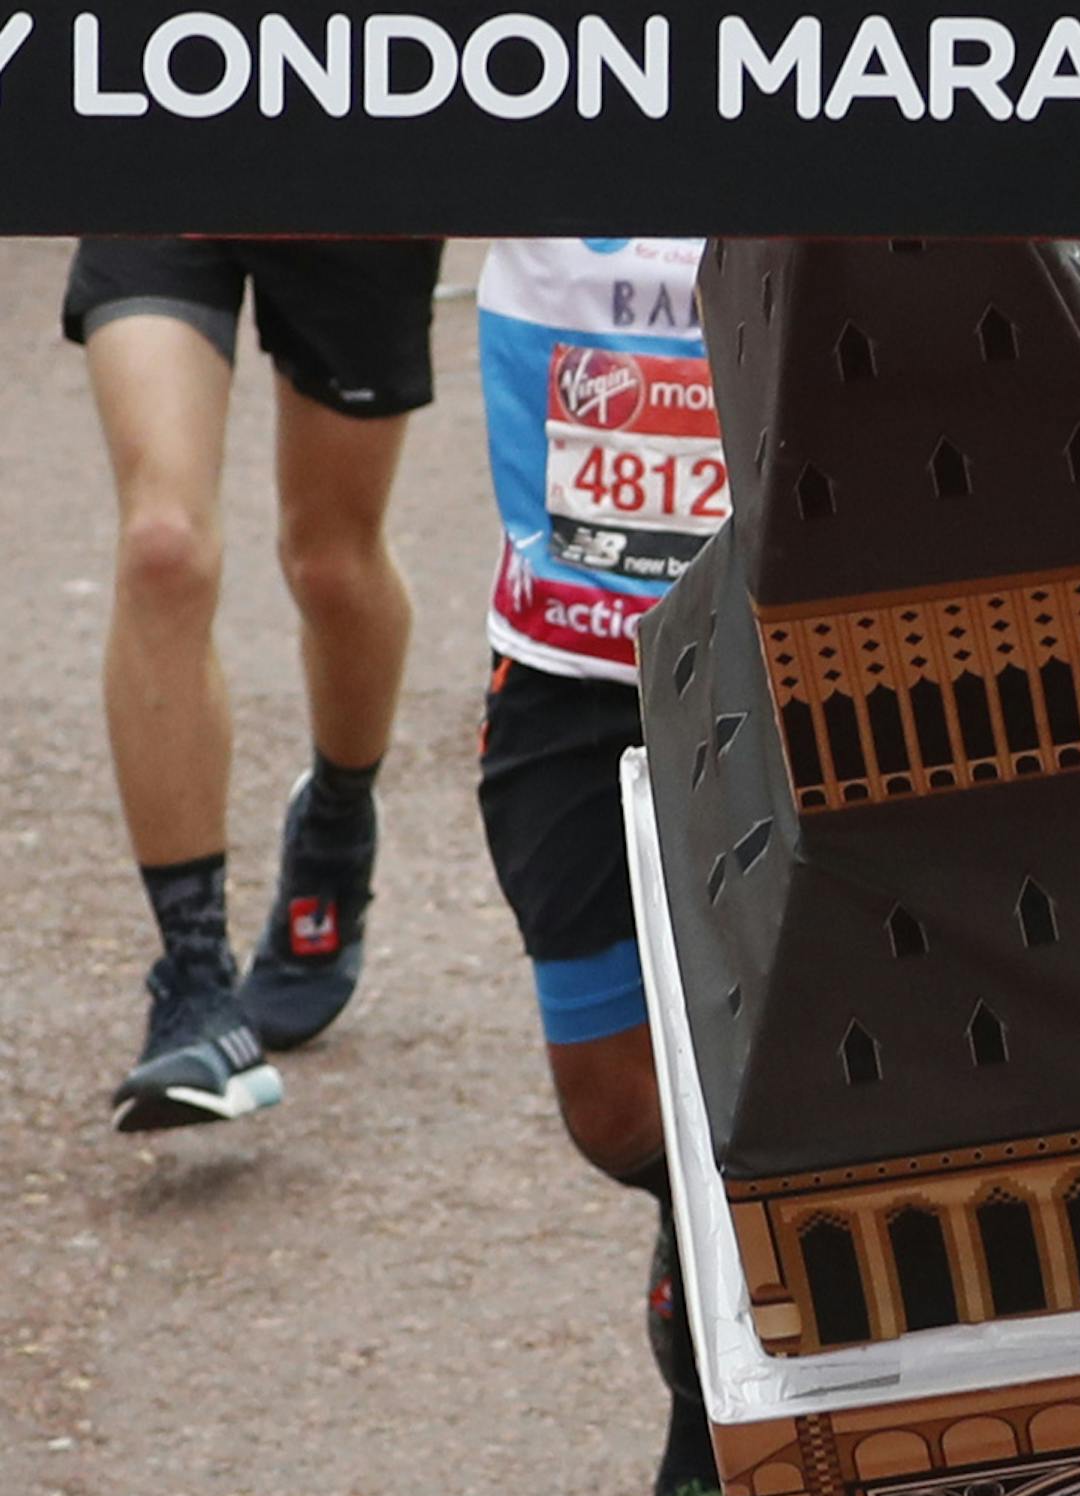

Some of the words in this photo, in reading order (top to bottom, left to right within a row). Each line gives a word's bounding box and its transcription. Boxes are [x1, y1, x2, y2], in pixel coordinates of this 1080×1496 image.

[73, 11, 669, 119] LONDON
[560, 349, 638, 425] Virgin
[573, 443, 728, 518] 4812
